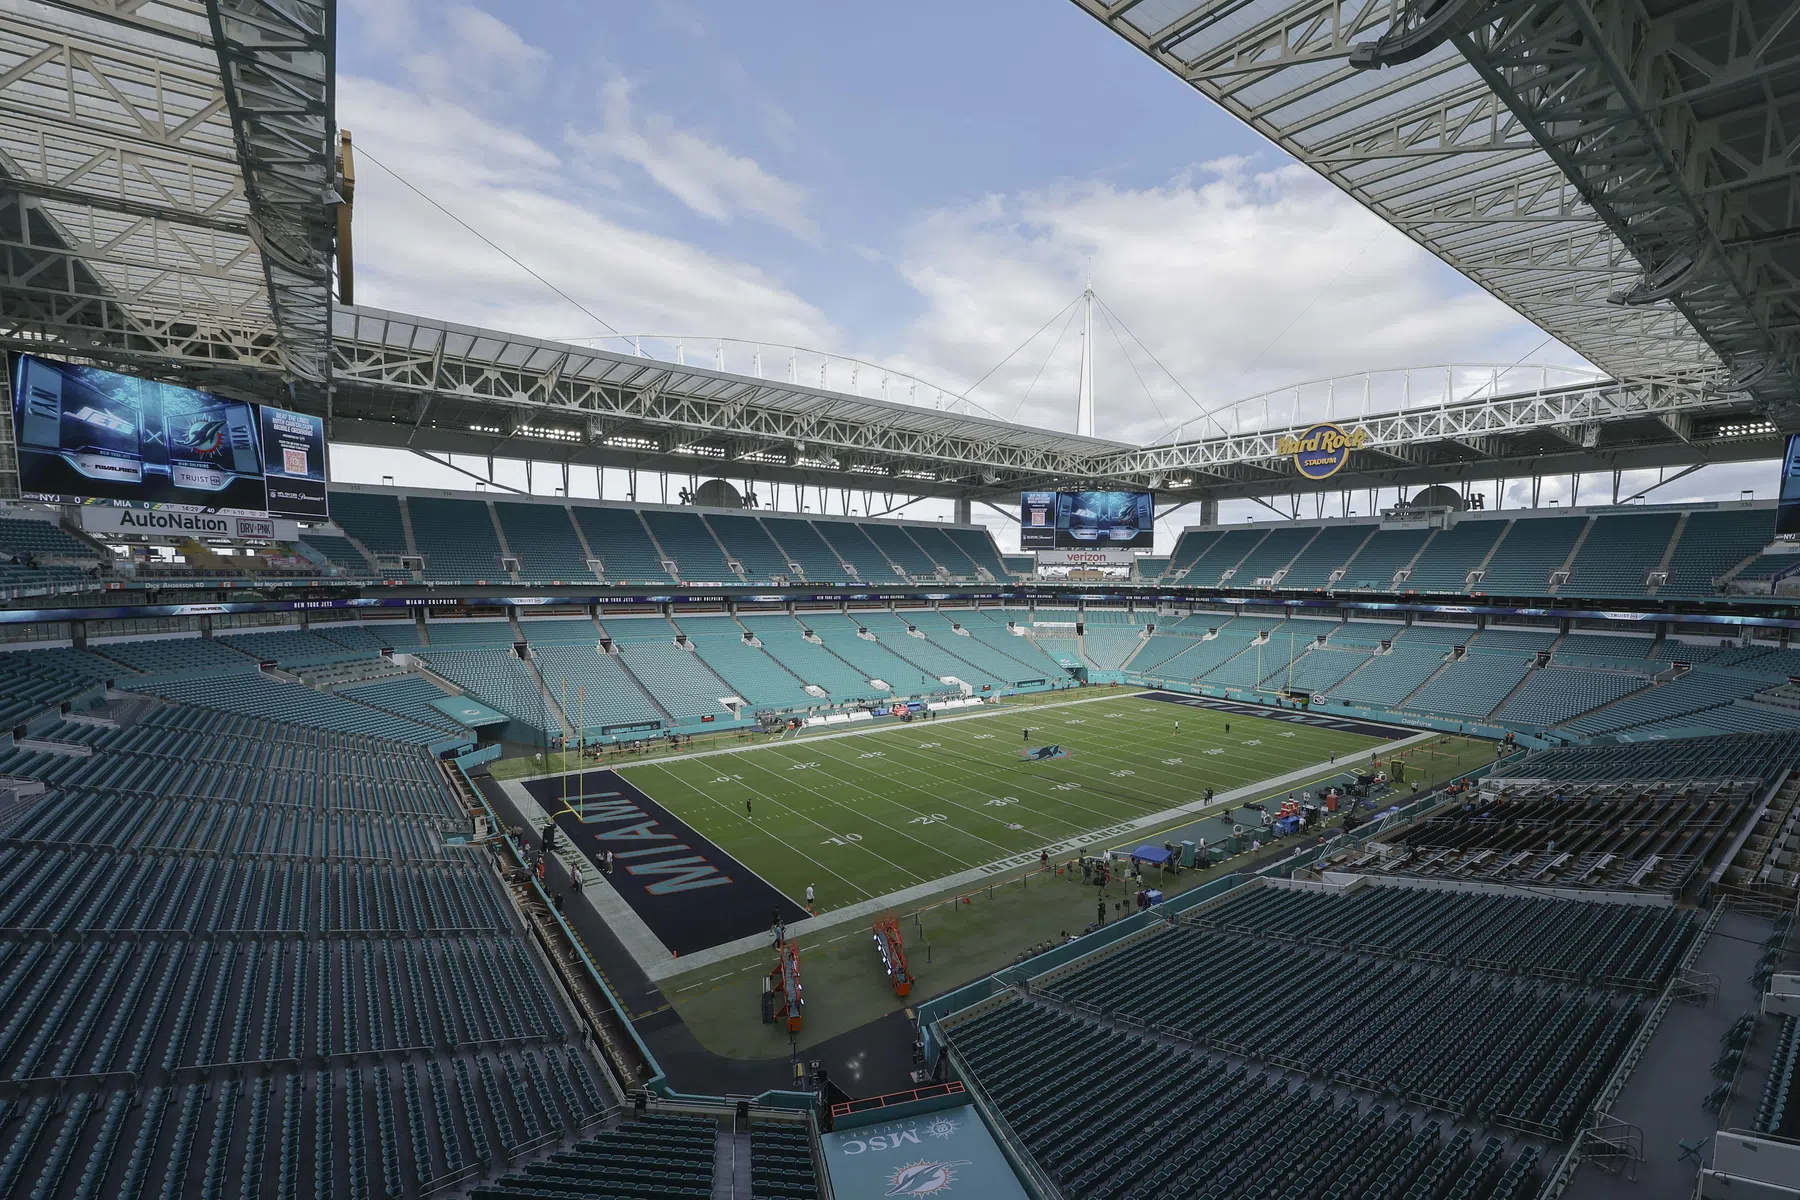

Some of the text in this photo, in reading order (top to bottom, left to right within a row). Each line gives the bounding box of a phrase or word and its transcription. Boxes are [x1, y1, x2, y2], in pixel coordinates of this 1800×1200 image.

[1304, 457, 1336, 466] STADIUM
[94, 464, 138, 474] RIVALRIES
[180, 474, 209, 483] TRUIST
[40, 494, 60, 502] NYJ
[120, 510, 227, 531] AutoNation
[240, 522, 270, 534] DRV PNK
[1067, 553, 1106, 562] verizon
[1402, 719, 1432, 727] Dolphins
[990, 796, 1019, 807] 30
[914, 813, 948, 825] 20
[558, 791, 734, 896] MIAMI
[829, 833, 863, 847] 10
[980, 822, 1138, 874] INTERCEPT CANCER
[840, 1121, 916, 1140] CRUISES
[843, 1128, 922, 1155] MSC
